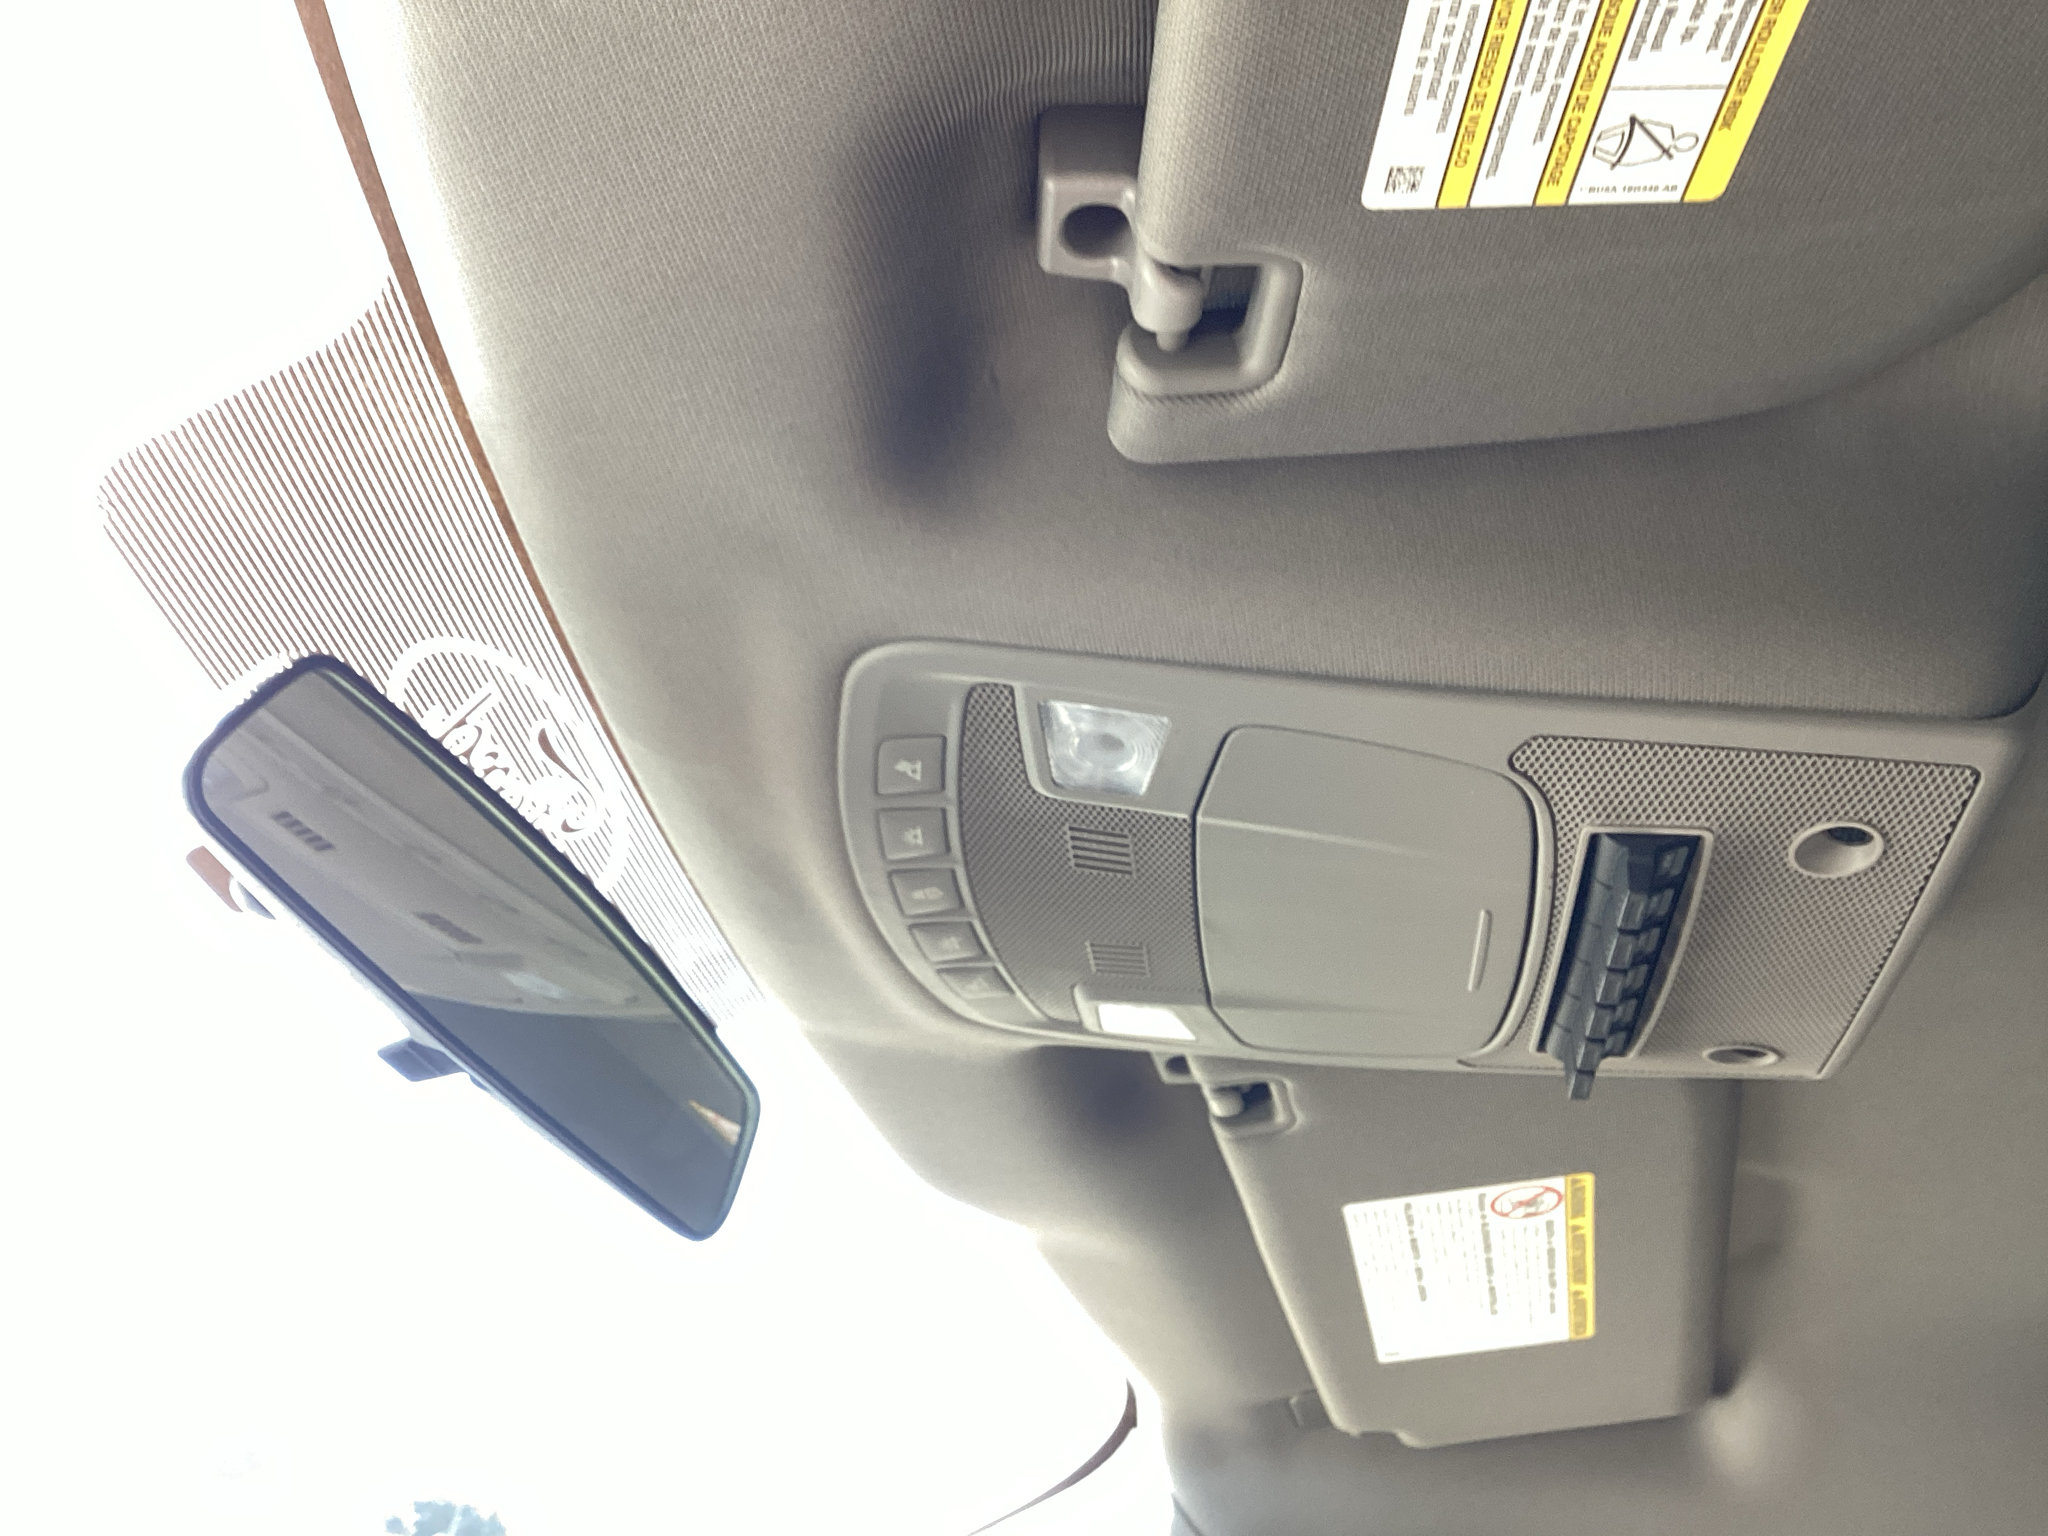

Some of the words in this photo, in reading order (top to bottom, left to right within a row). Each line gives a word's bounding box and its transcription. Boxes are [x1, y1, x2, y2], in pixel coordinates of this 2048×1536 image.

[1478, 32, 1504, 89] RIESGO
[1470, 91, 1488, 112] DE
[1454, 113, 1481, 168] VUELCO
[1546, 116, 1582, 187] CAPOTAGE
